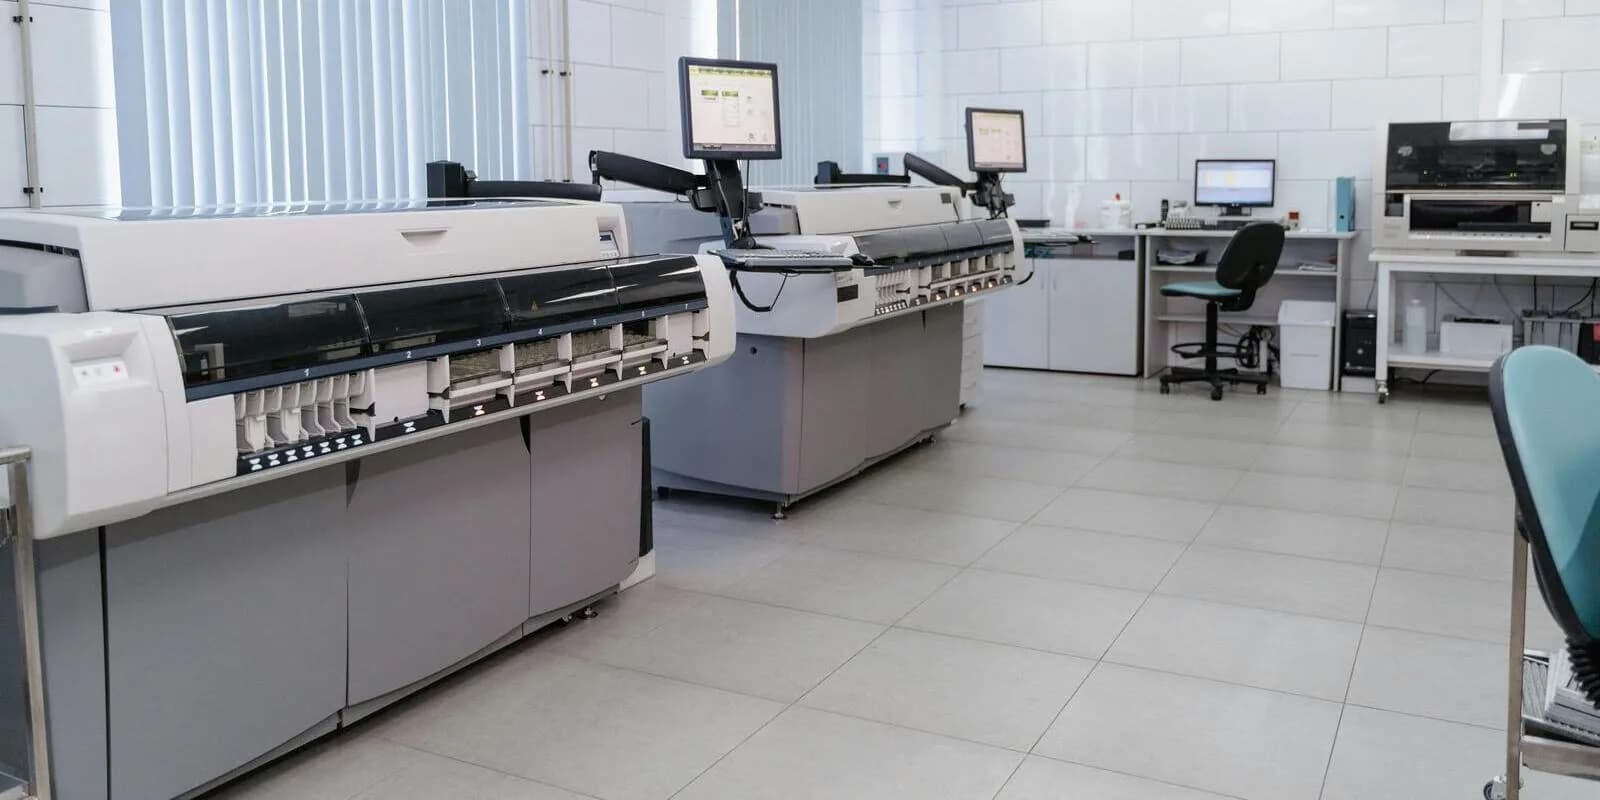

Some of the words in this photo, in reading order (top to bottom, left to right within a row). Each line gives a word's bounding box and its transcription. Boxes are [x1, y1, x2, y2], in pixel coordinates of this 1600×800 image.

[303, 368, 309, 377] 1
[405, 350, 412, 359] 2
[475, 338, 482, 346] 3
